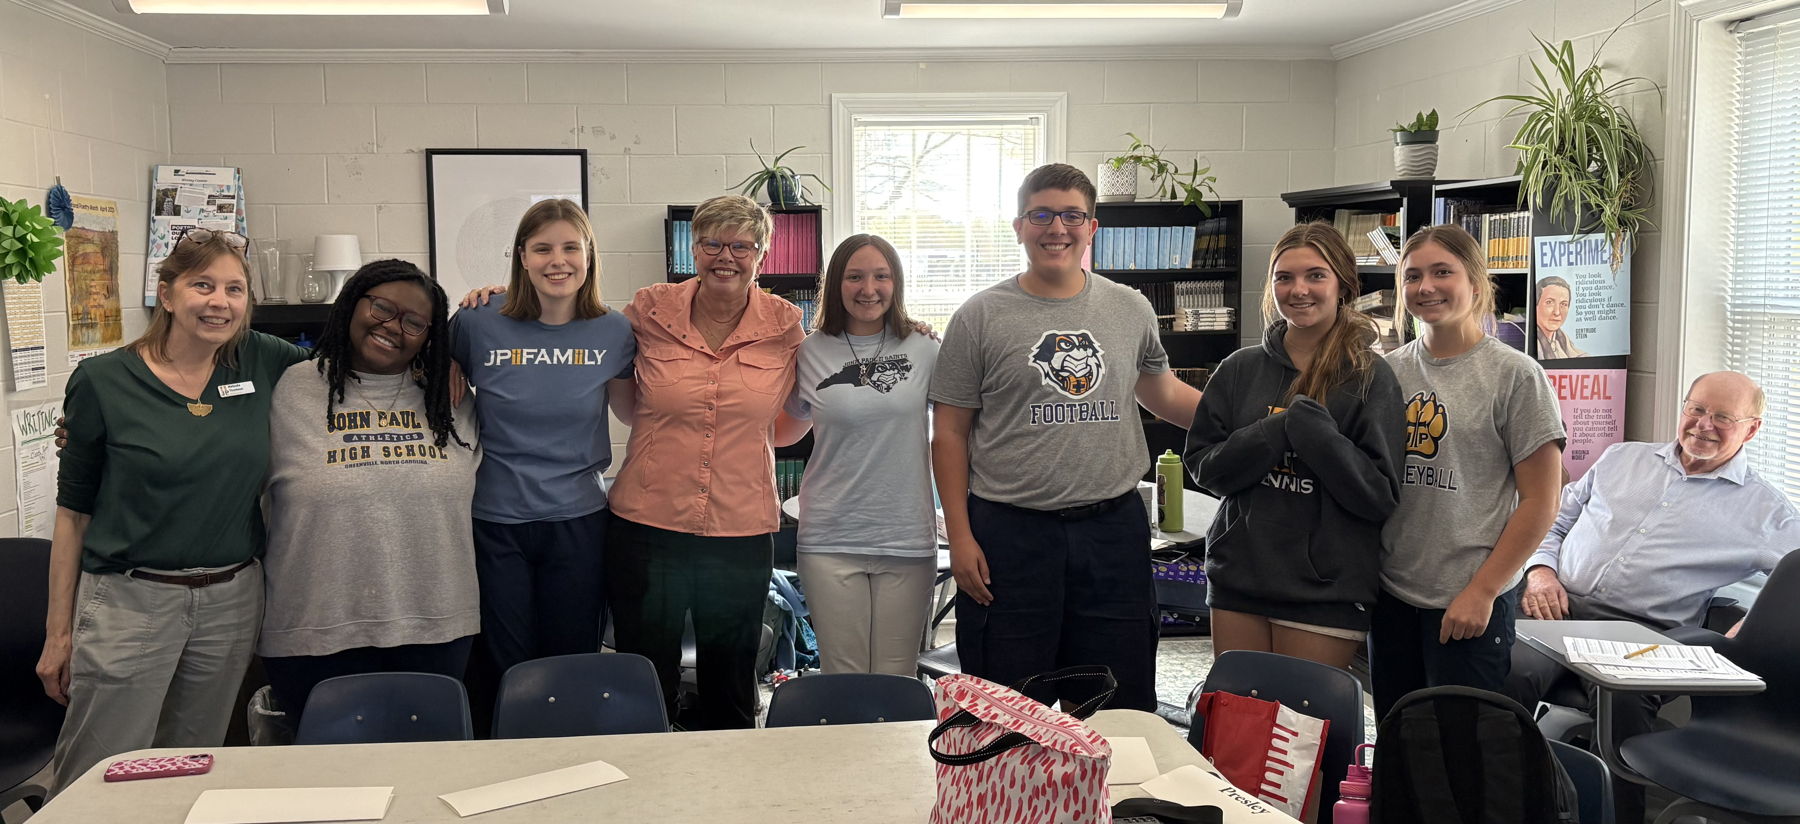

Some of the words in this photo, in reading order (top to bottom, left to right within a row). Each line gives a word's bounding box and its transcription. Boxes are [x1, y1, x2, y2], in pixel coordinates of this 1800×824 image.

[1540, 239, 1624, 268] EXPERIME
[327, 411, 371, 434] JOHN
[1030, 401, 1121, 425] FOOTBALL
[1591, 419, 1616, 427] yourself
[326, 445, 371, 465] HIGH
[382, 444, 448, 460] SCHOOL
[1260, 472, 1314, 494] NNIS
[1402, 464, 1459, 492] EYBLL
[1219, 786, 1271, 815] Presley
